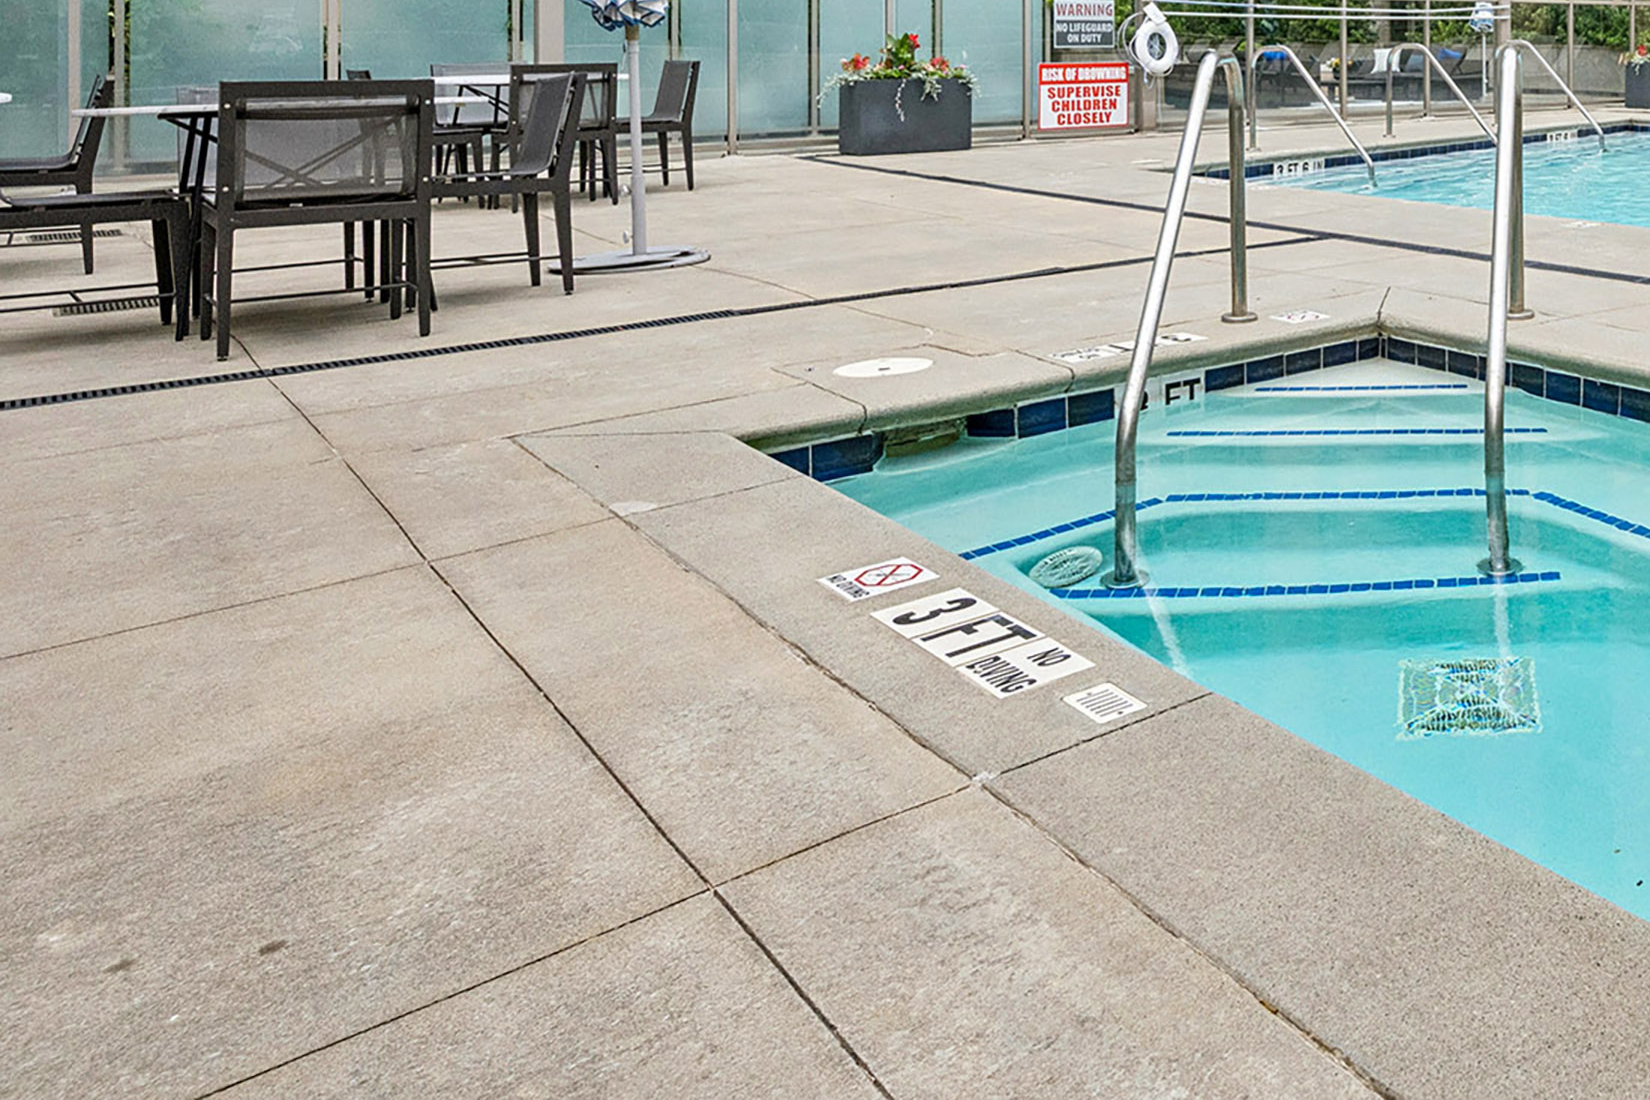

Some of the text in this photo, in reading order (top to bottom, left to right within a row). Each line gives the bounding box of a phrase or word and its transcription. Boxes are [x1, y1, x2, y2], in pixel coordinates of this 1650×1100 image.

[1056, 3, 1113, 16] WARNING
[1056, 22, 1113, 33] NO LIFEGUARD
[1067, 33, 1102, 43] ON DUTY
[1042, 66, 1126, 81] RISK OF DROWNING
[1047, 85, 1121, 99] SUPERVISE
[1051, 98, 1117, 112] CHILDREN
[1057, 111, 1112, 125] CLOSELY
[1165, 377, 1200, 405] FT
[892, 597, 1037, 658] 3 FT
[1026, 647, 1071, 667] NO
[965, 655, 1038, 694] DIVING
